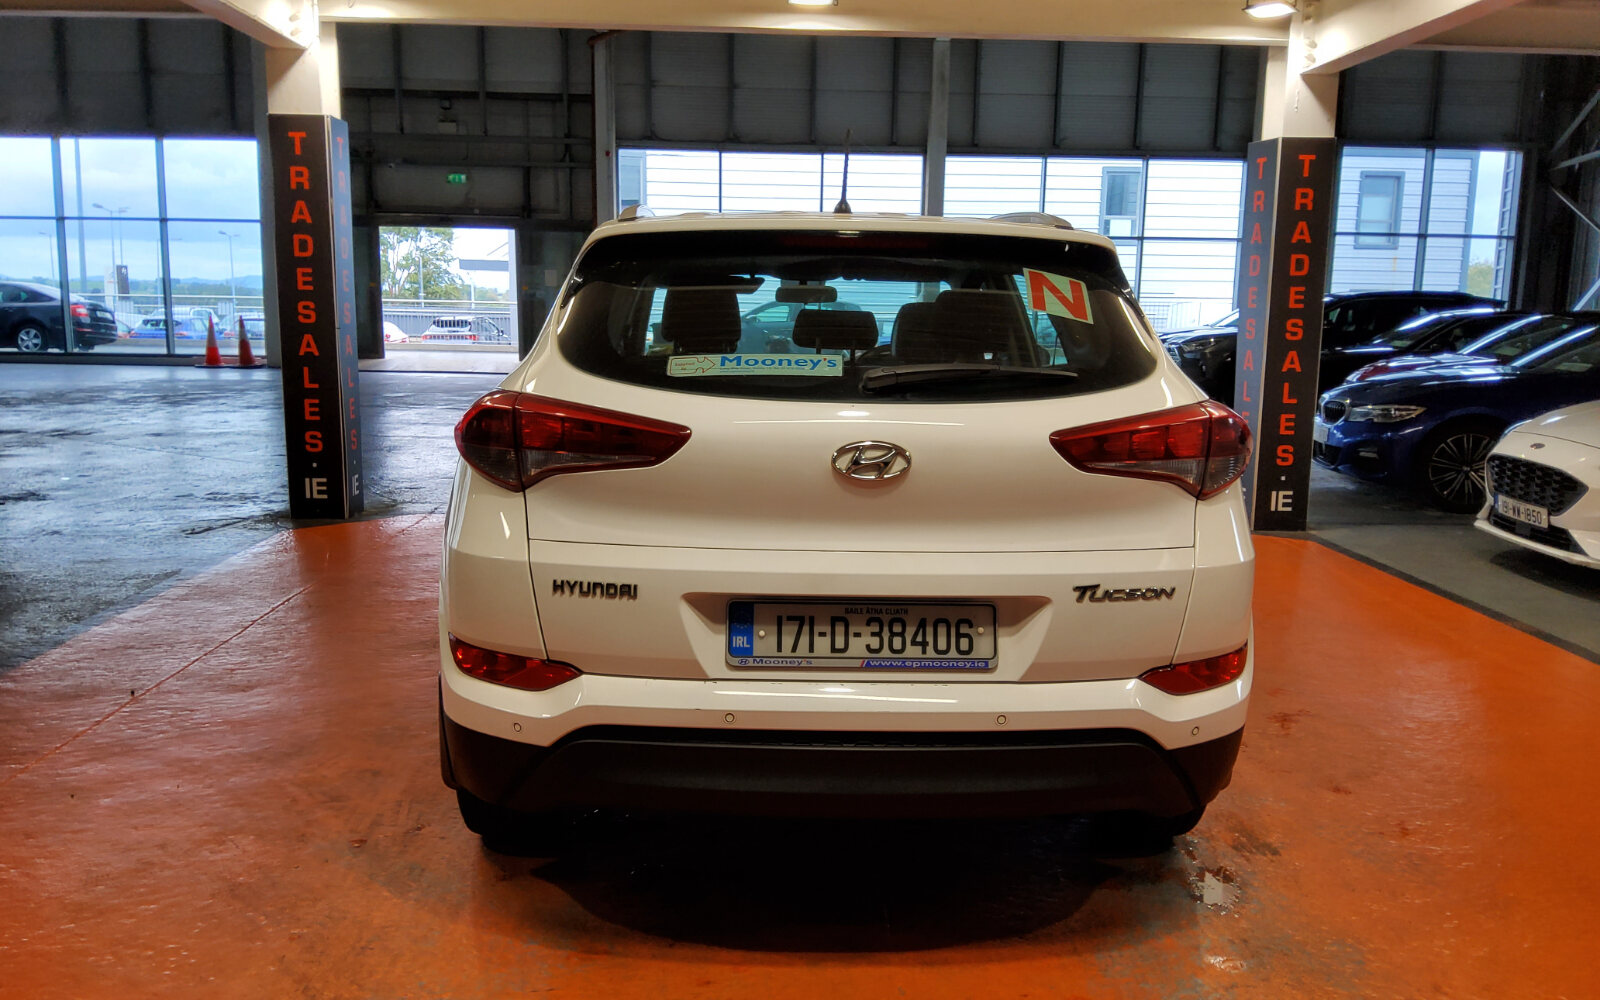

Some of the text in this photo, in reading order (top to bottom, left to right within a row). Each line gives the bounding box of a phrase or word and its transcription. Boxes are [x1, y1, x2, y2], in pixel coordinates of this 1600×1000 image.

[1028, 270, 1088, 321] N
[720, 355, 837, 370] Mooney's
[552, 579, 638, 600] HYUNDAI
[1072, 584, 1176, 603] TUCSON
[732, 636, 751, 648] IRL
[776, 615, 974, 655] 171-D-38406
[752, 658, 813, 667] Mooney's
[869, 659, 986, 669] www.epmooney.ie
